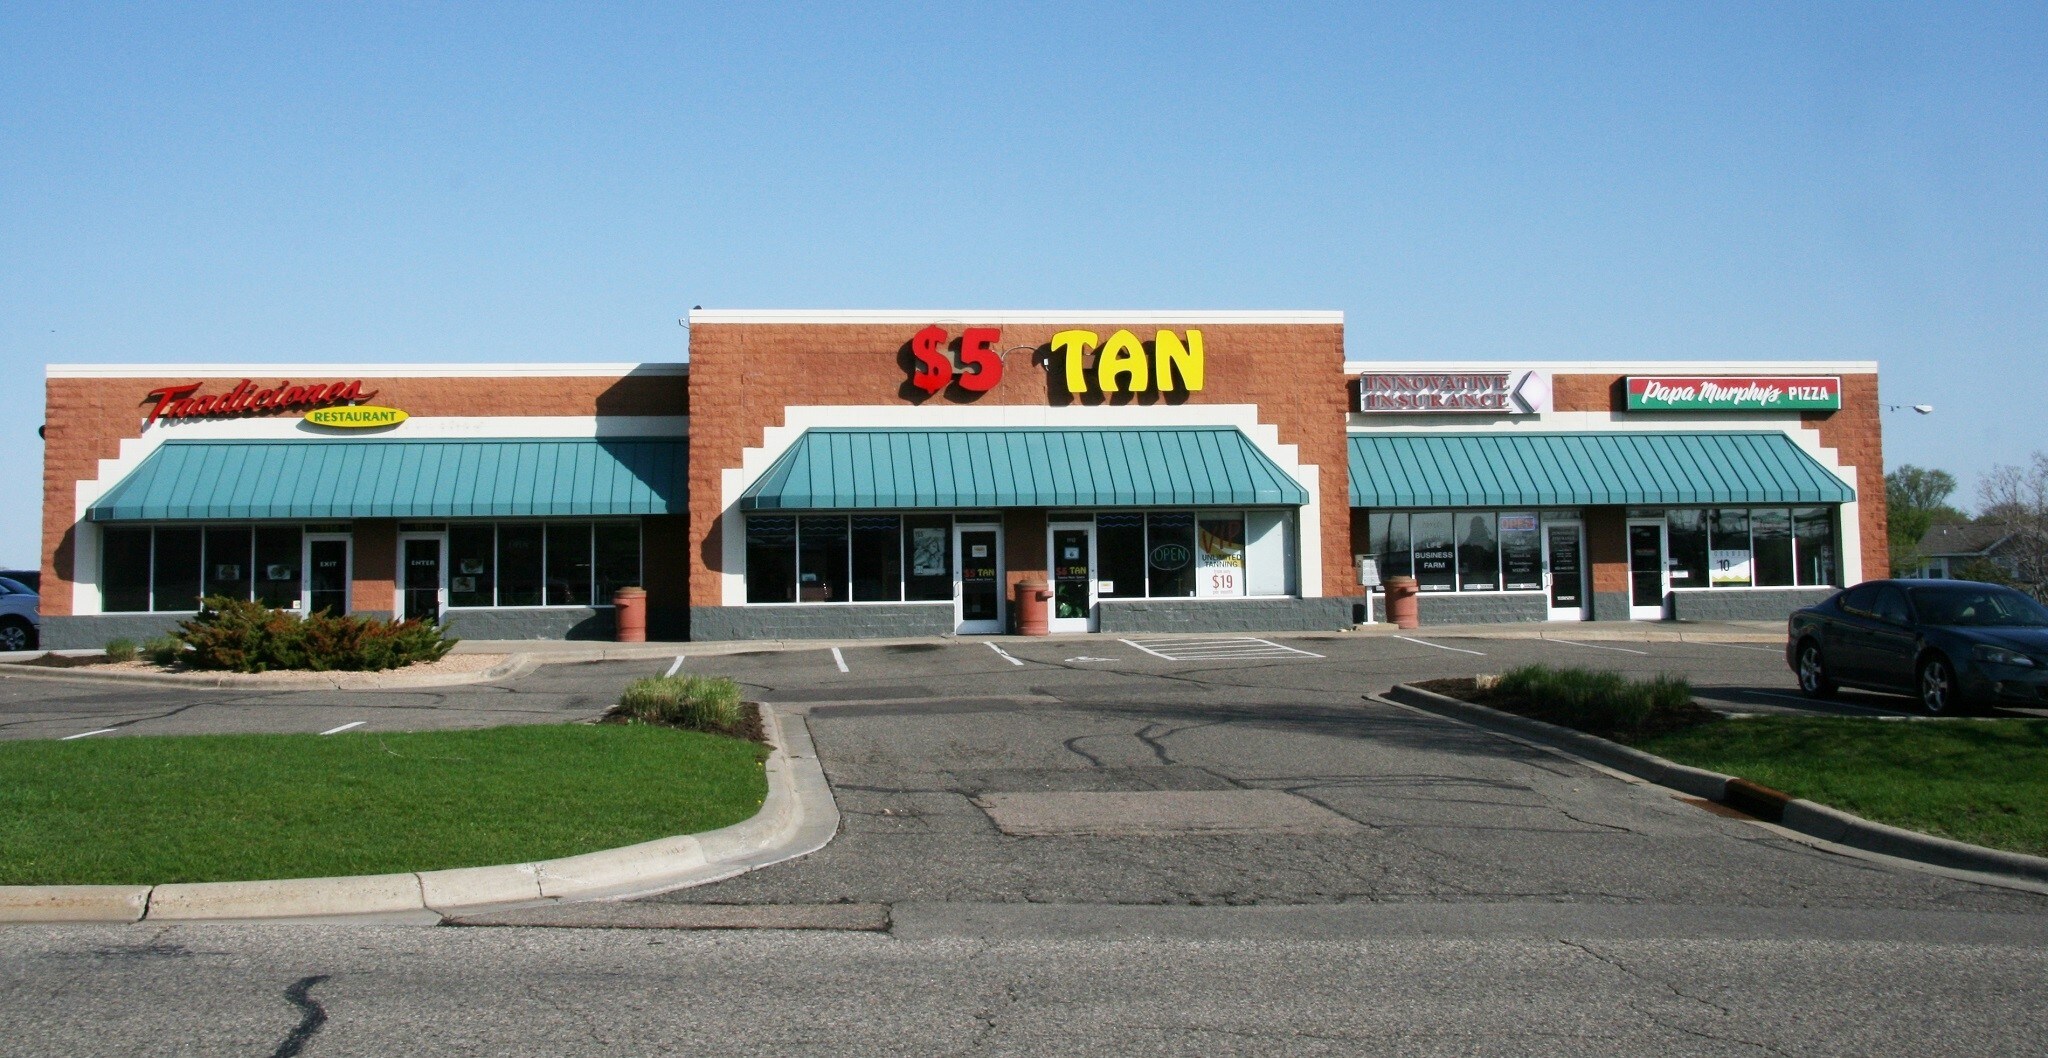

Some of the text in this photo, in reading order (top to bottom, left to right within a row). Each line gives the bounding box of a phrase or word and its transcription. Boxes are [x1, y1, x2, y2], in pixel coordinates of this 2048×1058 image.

[911, 324, 1204, 394] $5 TAN
[1366, 375, 1510, 390] INNOVATIVE
[1368, 393, 1510, 407] INSURANCE
[1641, 380, 1829, 406] Papa Murphy's PIZZA
[148, 378, 380, 424] Tradiciones
[313, 411, 397, 422] RESTAURANT
[1202, 521, 1241, 554] VIP
[1154, 547, 1186, 561] OPEN
[1415, 551, 1453, 559] BUSINESS
[977, 568, 995, 577] TAN
[1069, 566, 1087, 575] TAN
[1212, 574, 1233, 589] $19
